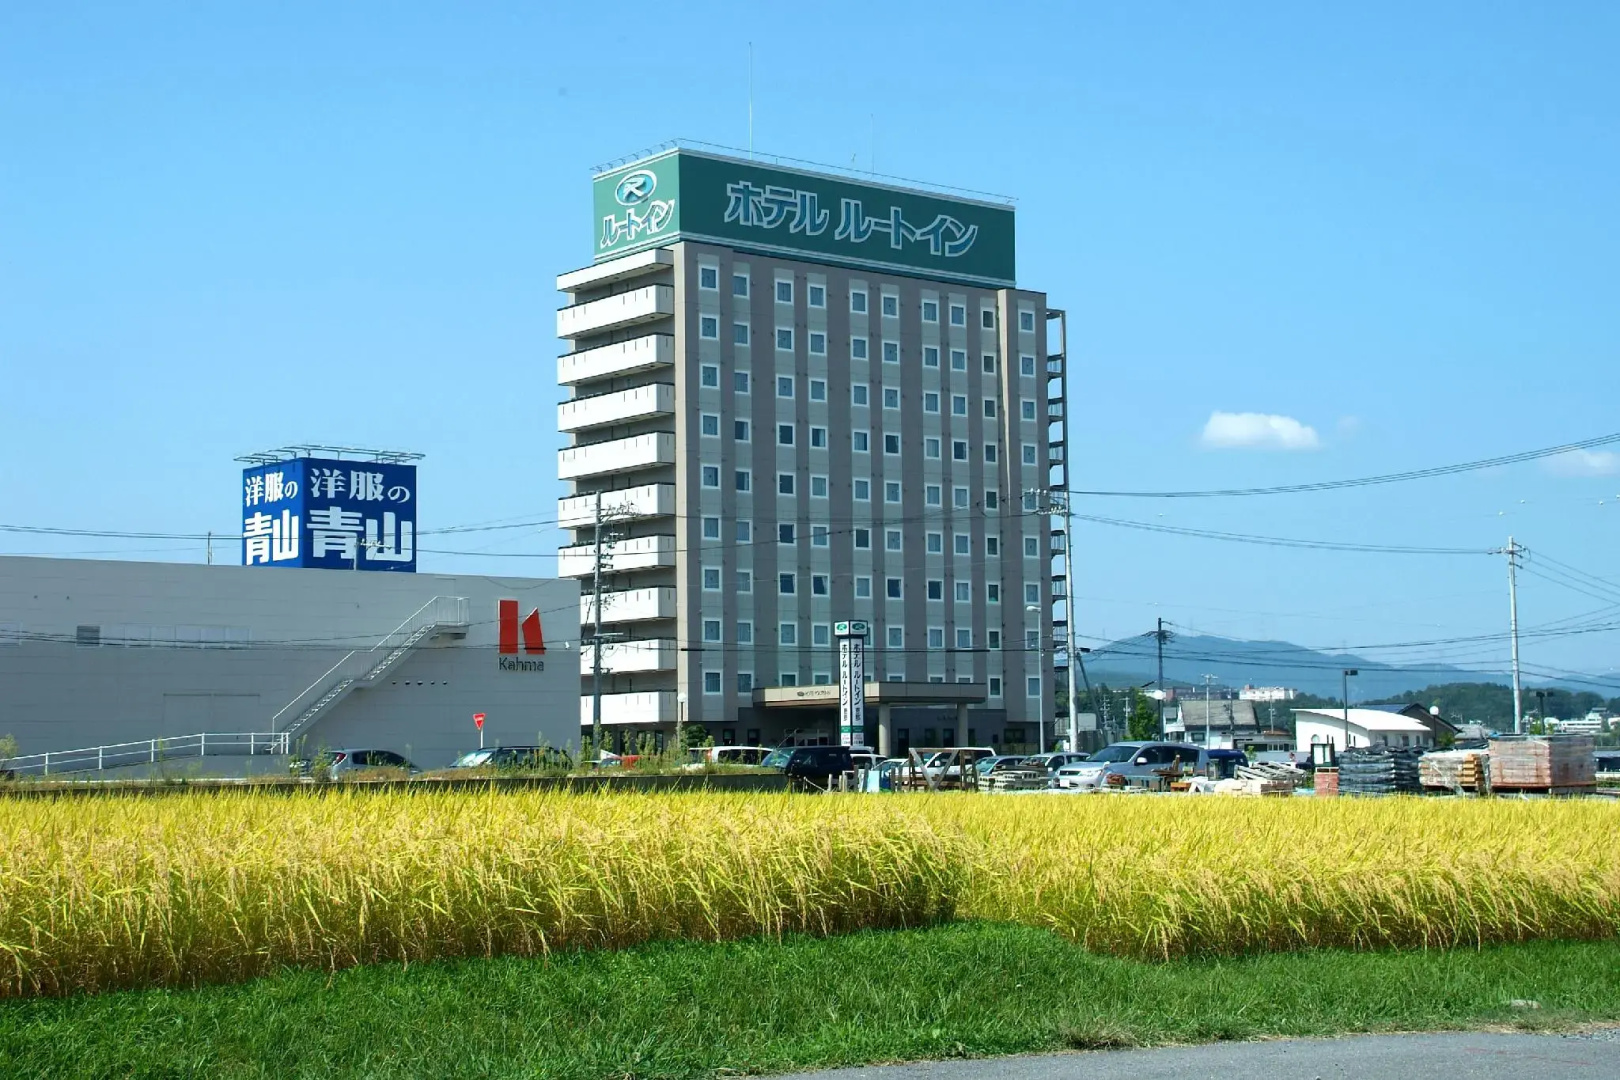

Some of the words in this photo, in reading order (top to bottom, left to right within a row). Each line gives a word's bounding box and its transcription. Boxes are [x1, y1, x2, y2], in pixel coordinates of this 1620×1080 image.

[600, 199, 675, 249] ルートイン
[723, 180, 830, 236] ホテル
[834, 198, 979, 258] ルートイン
[245, 471, 298, 507] 洋服の
[310, 467, 411, 504] 洋服の
[243, 509, 299, 566] 青山
[306, 505, 413, 563] 青山
[498, 656, 545, 672] Kahma
[853, 671, 861, 706] ルートイン
